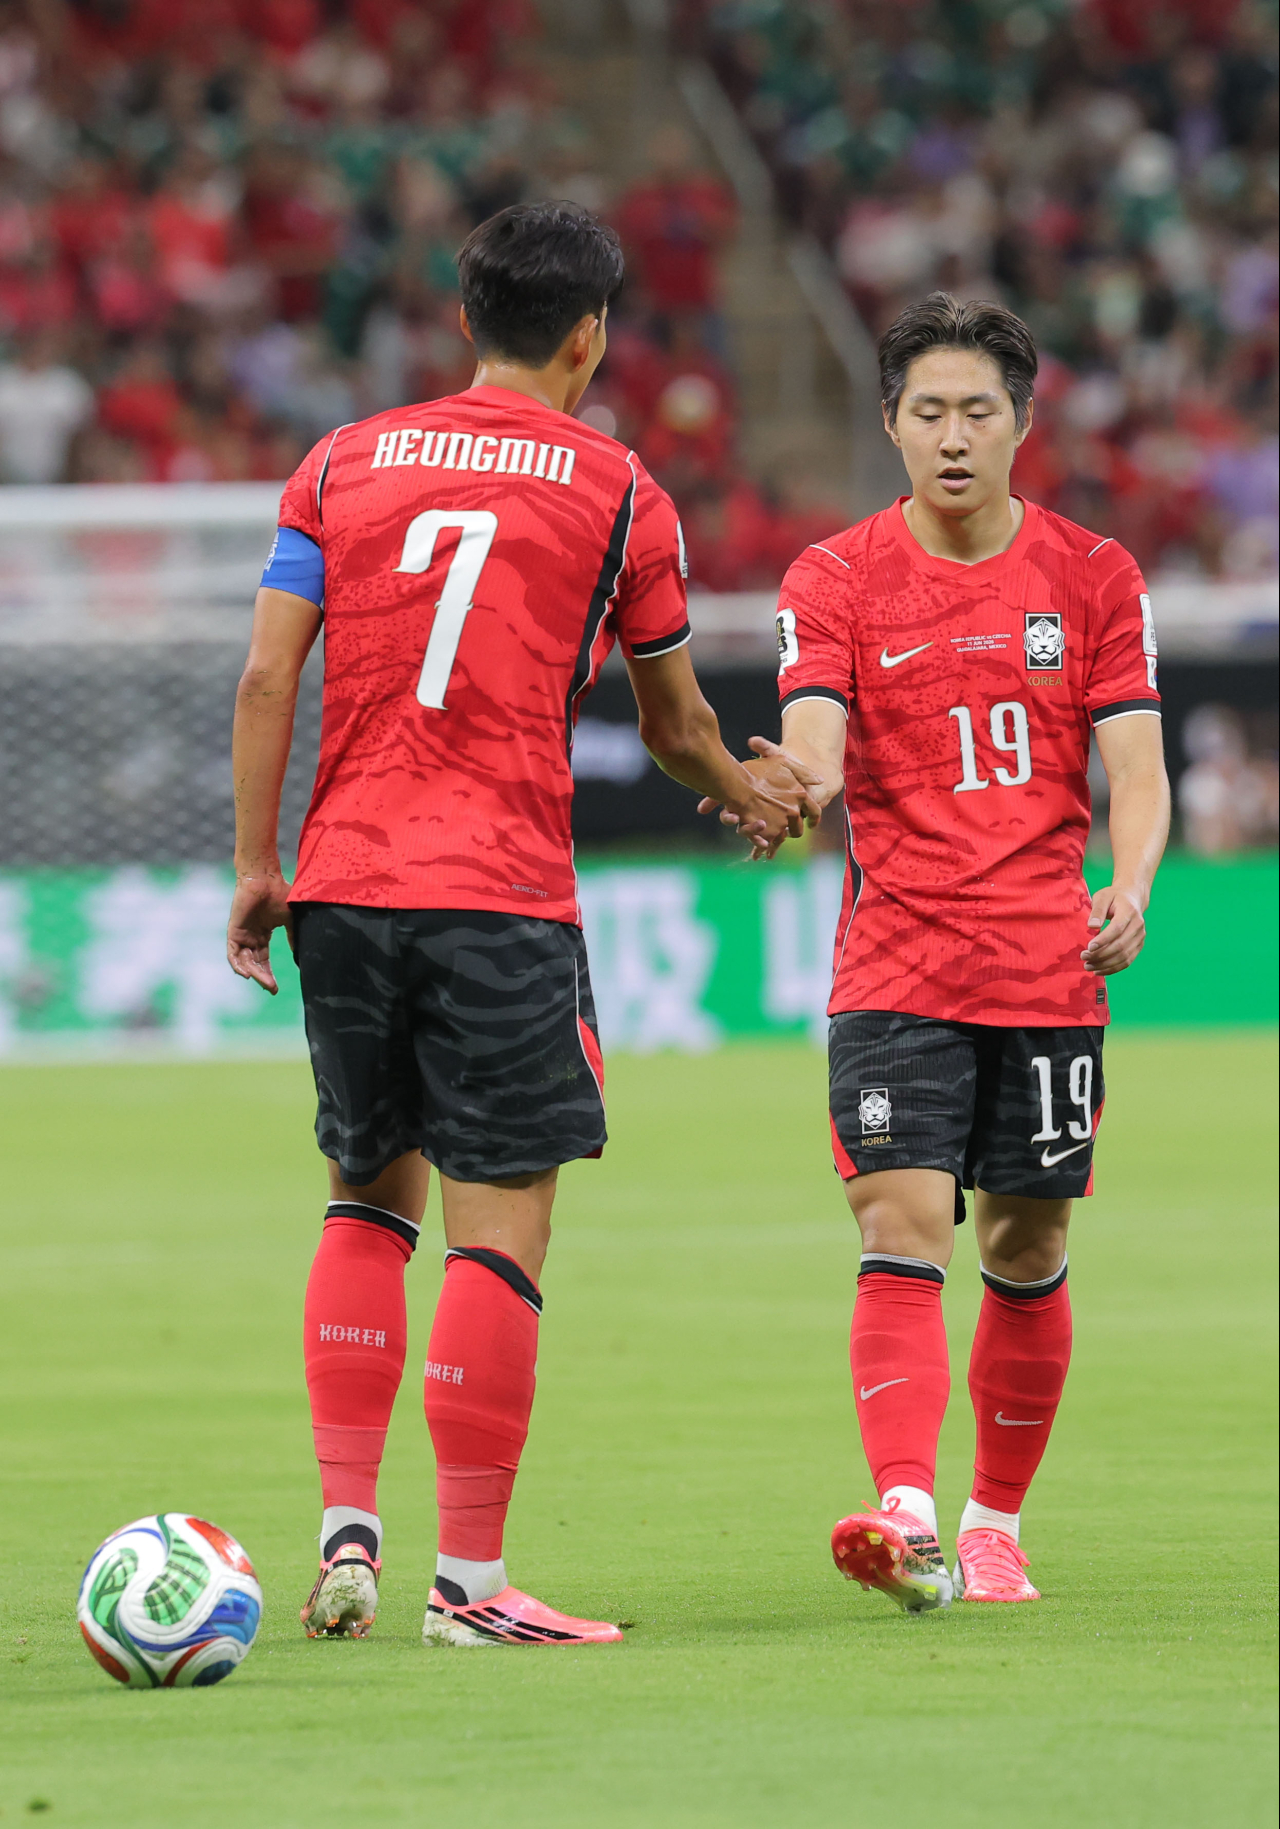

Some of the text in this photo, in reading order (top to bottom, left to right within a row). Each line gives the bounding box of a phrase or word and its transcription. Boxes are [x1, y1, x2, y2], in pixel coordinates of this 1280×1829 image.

[370, 428, 576, 485] HEUNGMIN
[391, 508, 499, 711] 7
[948, 701, 1032, 796] 19
[511, 883, 548, 898] AERO-FIT
[1030, 1055, 1093, 1145] 19
[861, 1135, 892, 1147] KOREA
[319, 1323, 386, 1348] KOREA
[424, 1360, 464, 1386] OREA
